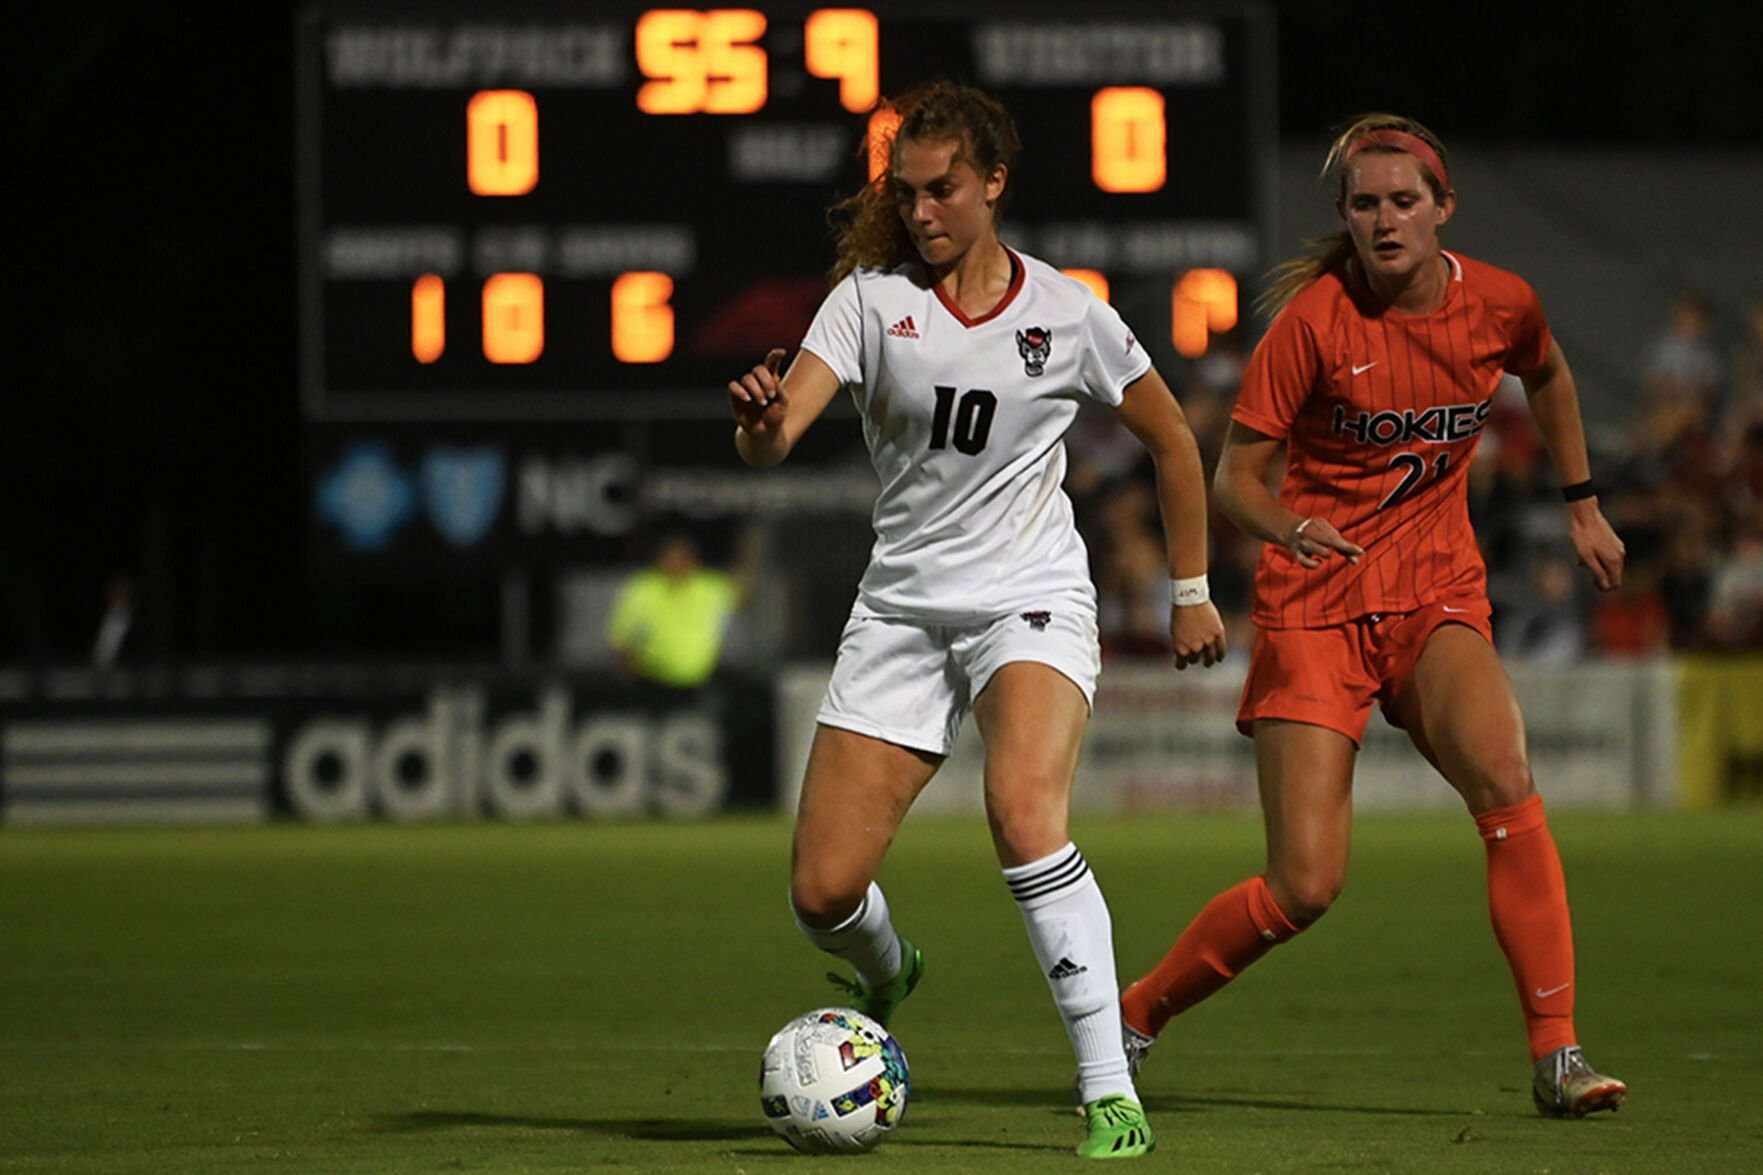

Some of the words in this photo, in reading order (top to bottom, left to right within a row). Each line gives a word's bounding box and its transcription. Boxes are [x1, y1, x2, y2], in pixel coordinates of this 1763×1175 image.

[467, 89, 538, 196] 0
[1092, 86, 1166, 193] 0
[929, 386, 998, 456] 10
[1333, 399, 1492, 447] HOKIES
[286, 688, 725, 818] adidas
